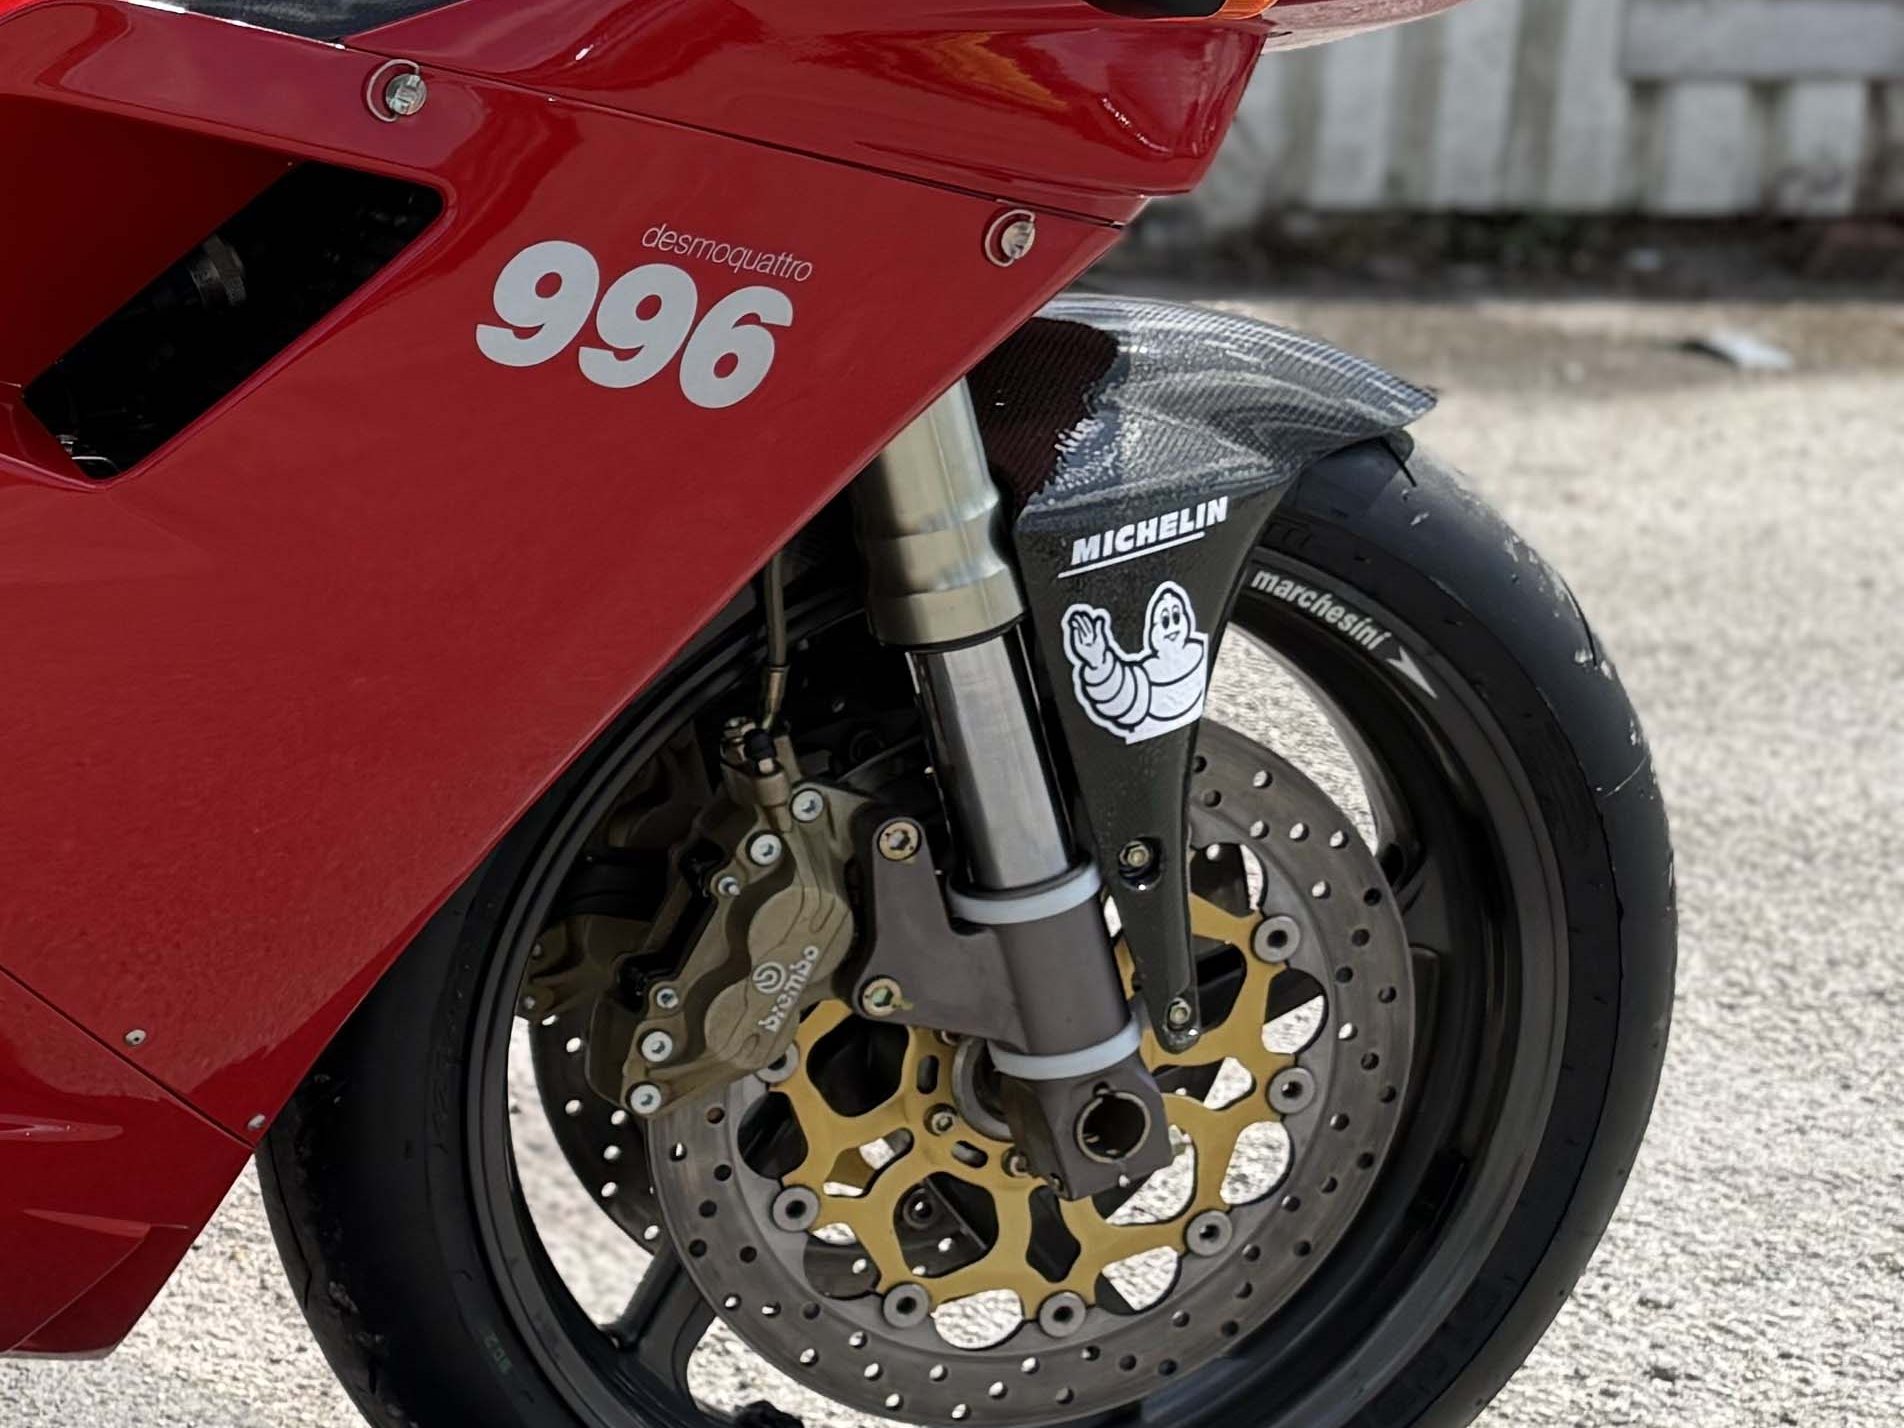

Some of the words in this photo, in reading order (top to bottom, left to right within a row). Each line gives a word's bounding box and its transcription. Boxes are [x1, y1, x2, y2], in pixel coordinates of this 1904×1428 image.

[641, 223, 813, 282] desmoquattro
[476, 240, 793, 409] 996
[1070, 496, 1228, 567] MICHELIN
[1251, 569, 1391, 651] marchesini
[757, 945, 819, 1032] brembo
